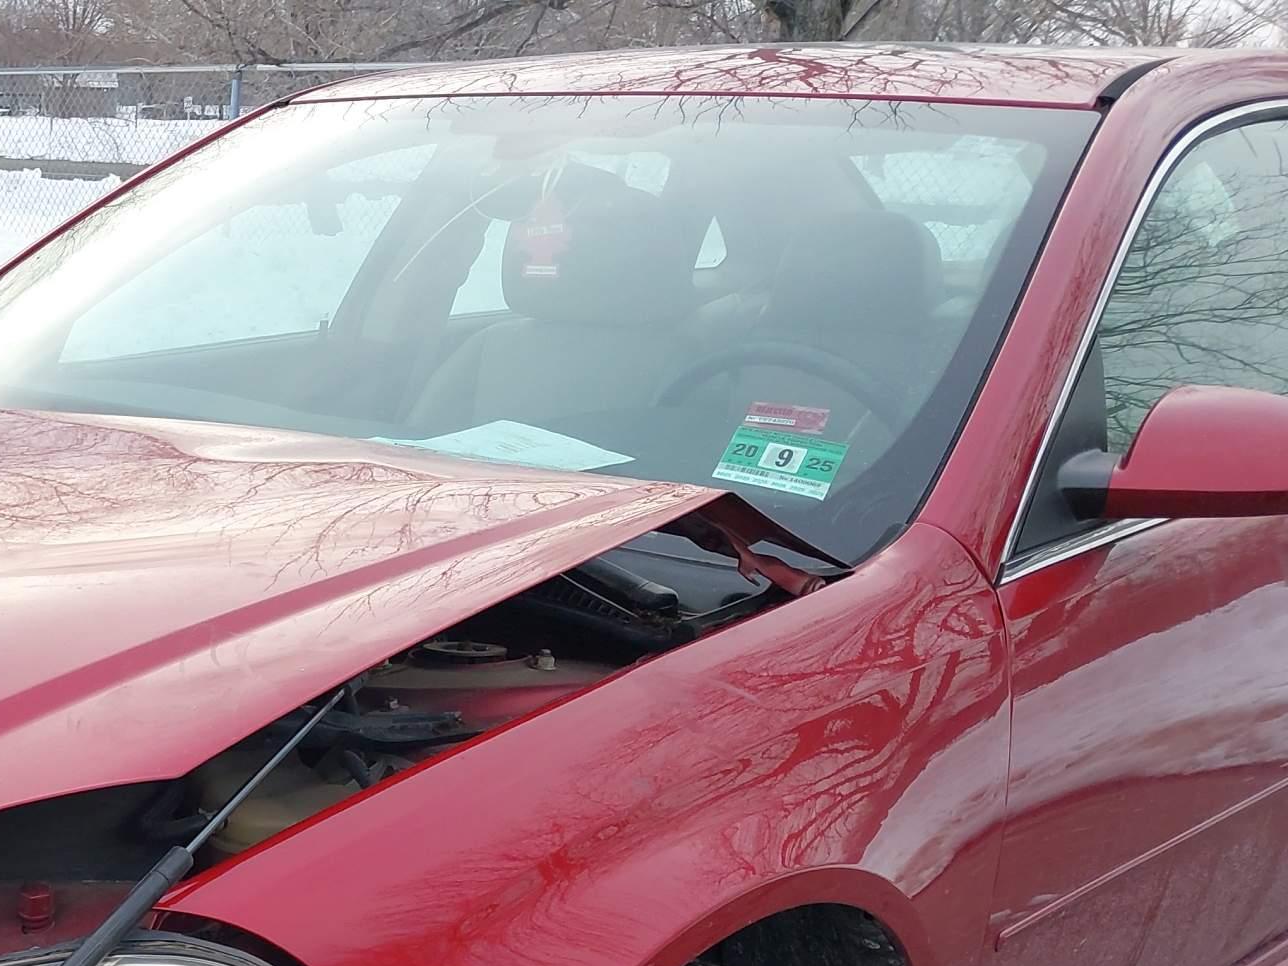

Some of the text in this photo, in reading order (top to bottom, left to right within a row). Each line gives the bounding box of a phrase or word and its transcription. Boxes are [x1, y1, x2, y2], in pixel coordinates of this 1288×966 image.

[732, 443, 835, 473] 20 9 25
